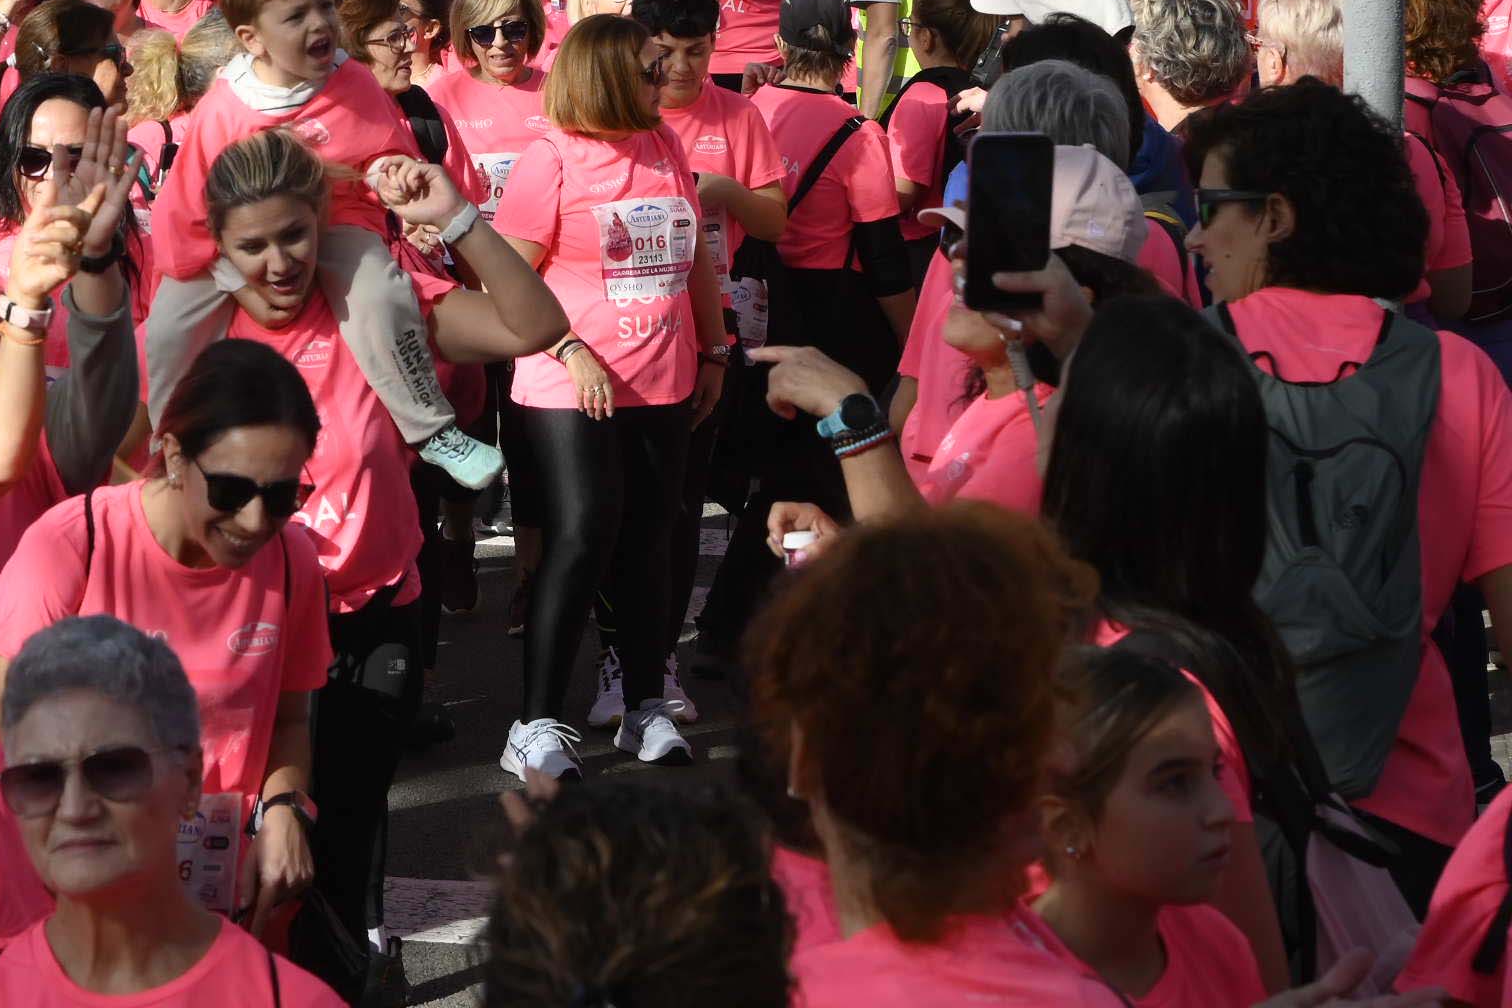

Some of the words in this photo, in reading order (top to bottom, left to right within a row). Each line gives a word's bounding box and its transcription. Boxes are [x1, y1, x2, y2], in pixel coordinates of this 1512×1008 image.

[634, 234, 666, 252] 016
[638, 253, 664, 265] 23113
[612, 267, 641, 278] CARRERA
[641, 266, 649, 275] DE
[650, 265, 658, 274] LA
[404, 329, 425, 365] RUN
[395, 337, 418, 376] JUMP
[413, 377, 433, 408] HIGH
